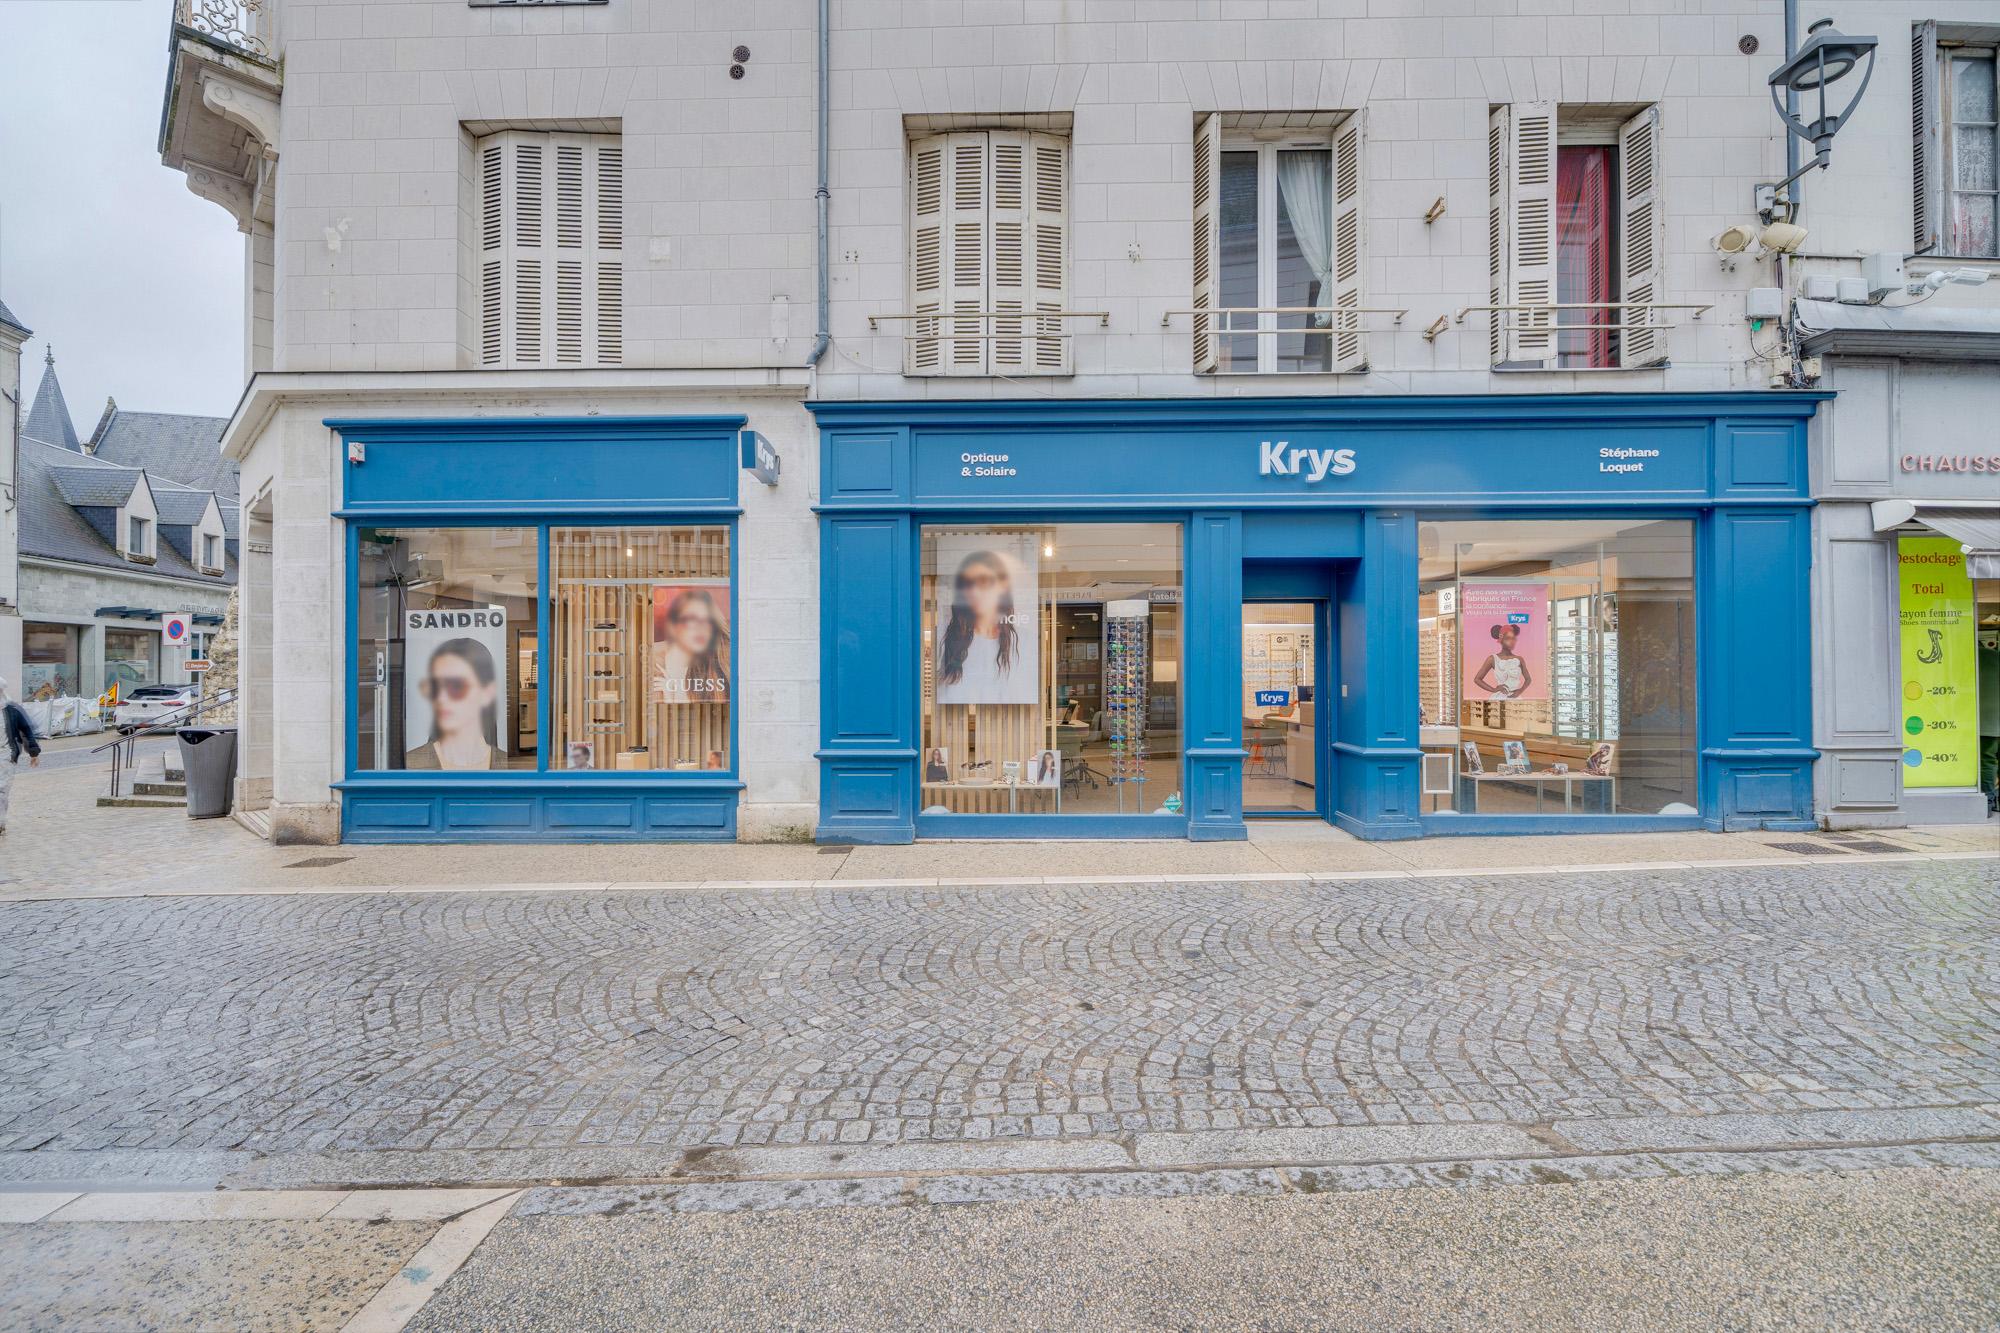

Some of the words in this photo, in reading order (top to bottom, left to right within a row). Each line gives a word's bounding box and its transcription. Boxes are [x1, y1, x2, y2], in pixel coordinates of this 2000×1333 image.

[961, 452, 1009, 464] Optique
[1600, 447, 1660, 460] Stéphane
[1260, 441, 1356, 482] Krys
[1900, 454, 2000, 472] CHAUSS
[961, 466, 974, 477] &
[975, 466, 1017, 477] Solaire
[1600, 462, 1644, 474] Loquet
[1912, 582, 1944, 595] Total
[1511, 614, 1526, 623] Krys
[1929, 608, 1962, 618] femme
[409, 612, 504, 629] SANDRO
[665, 678, 726, 692] GUESS
[1926, 686, 1956, 695] -20%
[1261, 693, 1284, 703] Krys
[1926, 720, 1957, 730] -30%
[1926, 753, 1958, 762] -40%
